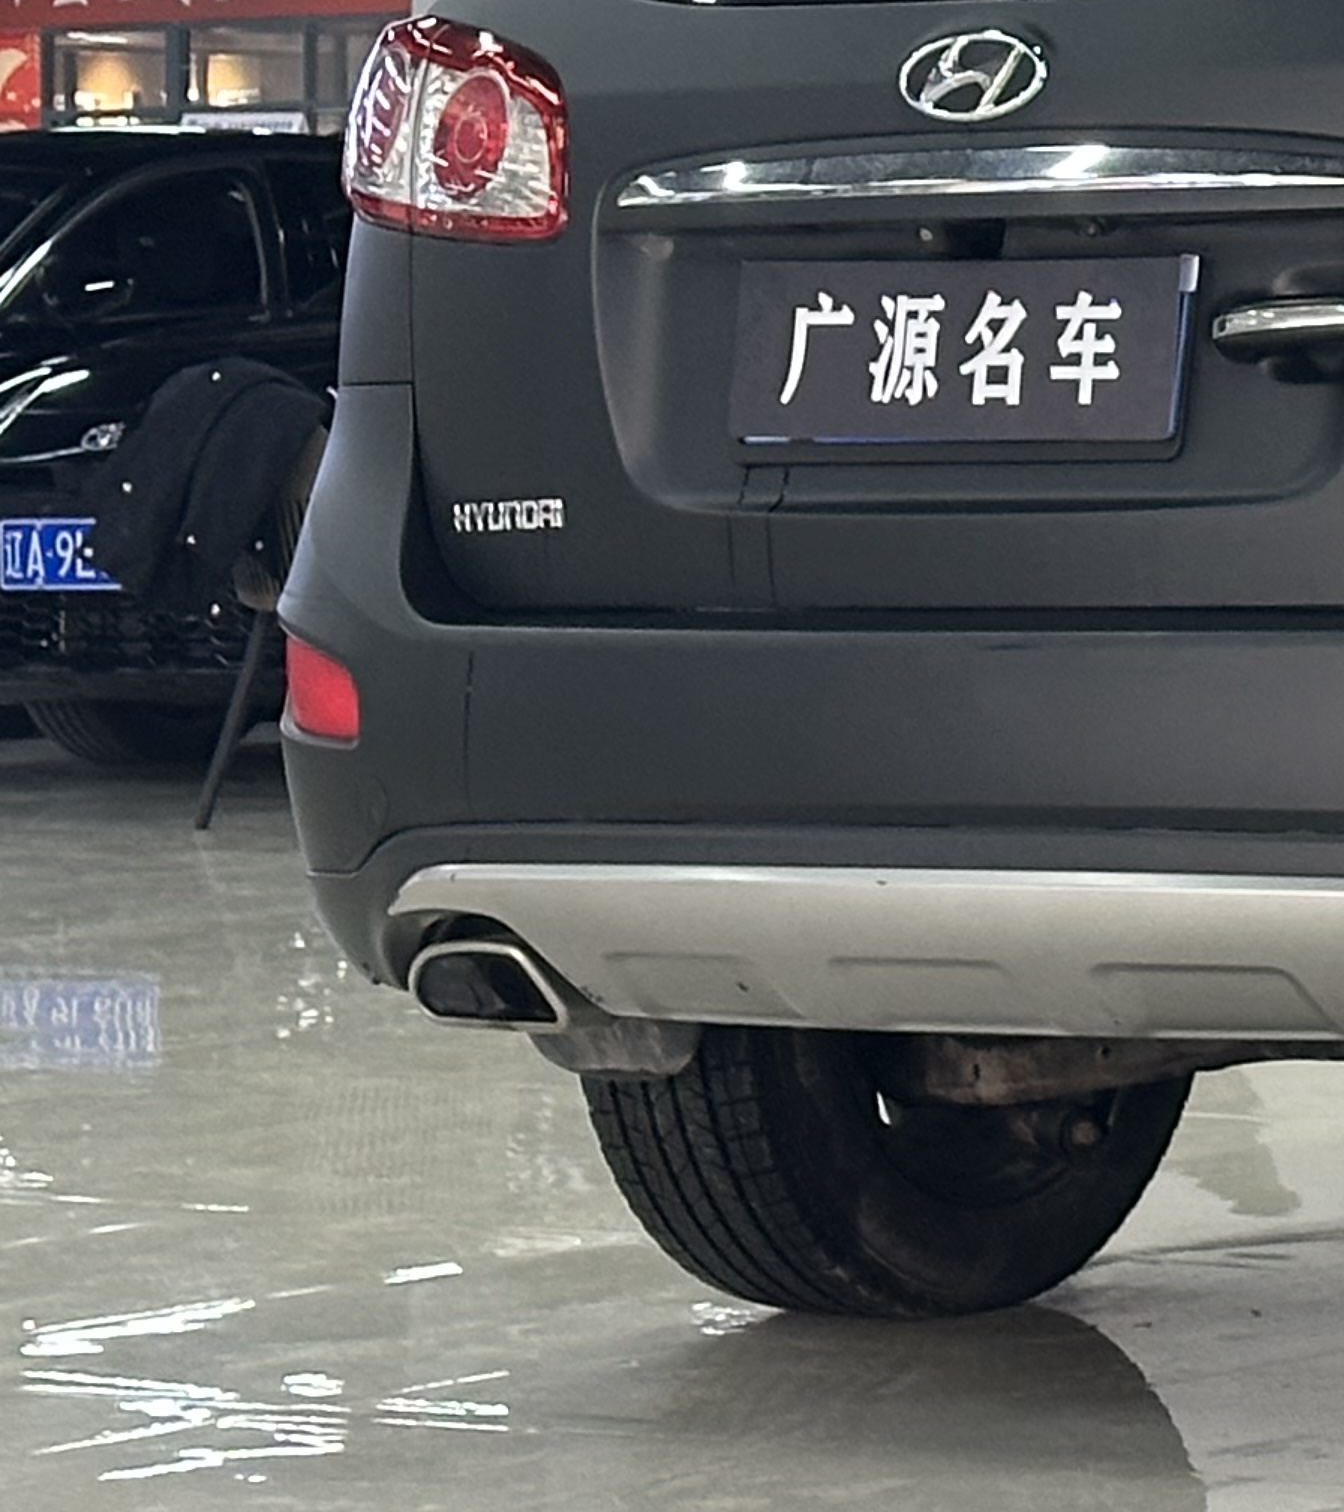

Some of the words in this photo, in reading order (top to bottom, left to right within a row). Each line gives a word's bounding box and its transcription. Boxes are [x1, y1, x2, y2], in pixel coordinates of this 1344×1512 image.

[779, 291, 1122, 406] 广源名车
[453, 498, 563, 532] HYUNDAI
